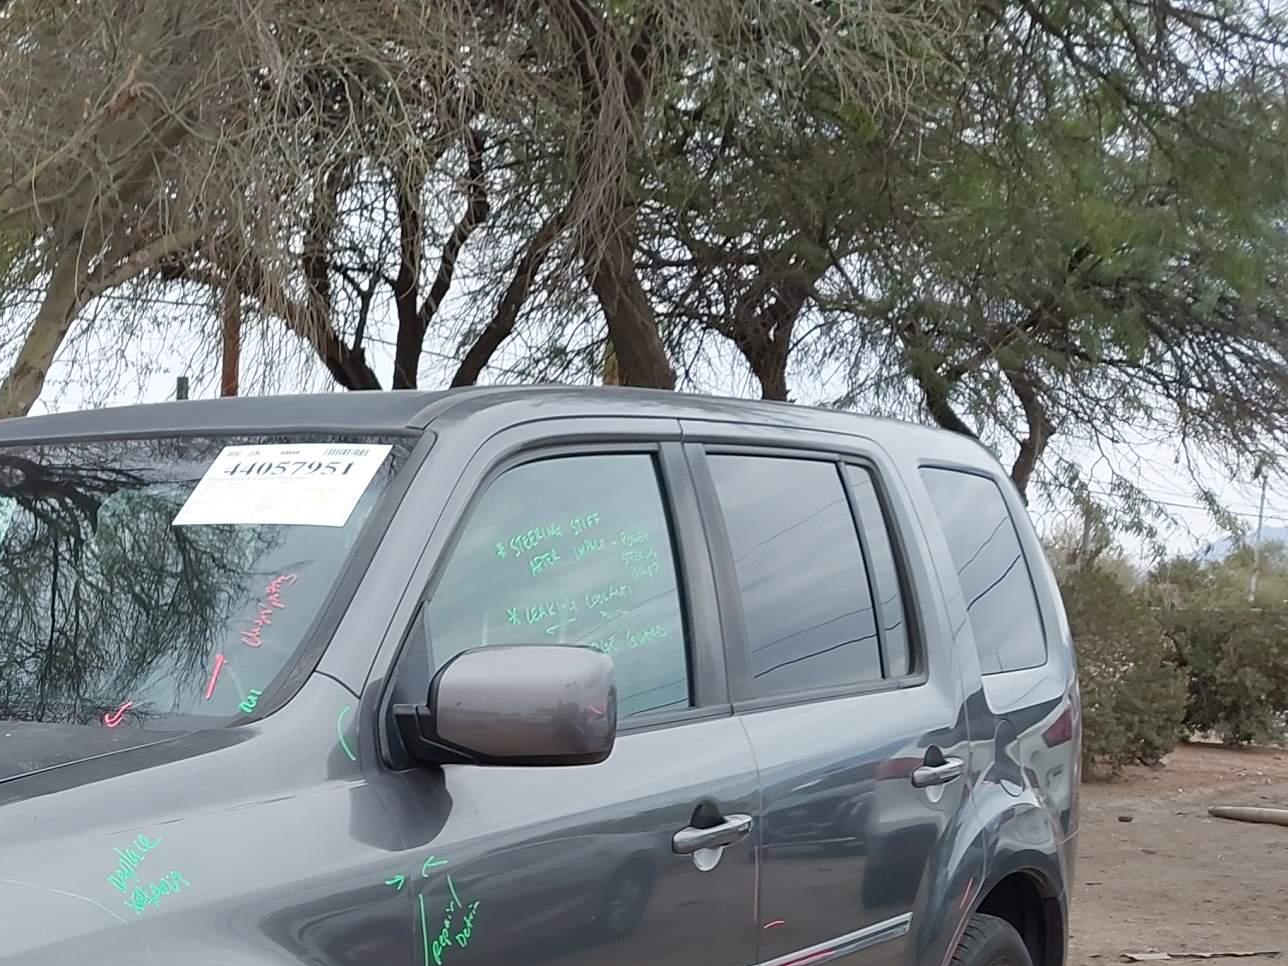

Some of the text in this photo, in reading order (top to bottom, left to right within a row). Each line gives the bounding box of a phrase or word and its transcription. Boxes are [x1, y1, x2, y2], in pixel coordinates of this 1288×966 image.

[223, 461, 355, 476] 44057951
[509, 512, 602, 558] STEERING STIFF
[528, 550, 561, 577] AFTER
[524, 598, 578, 626] LEAKING
